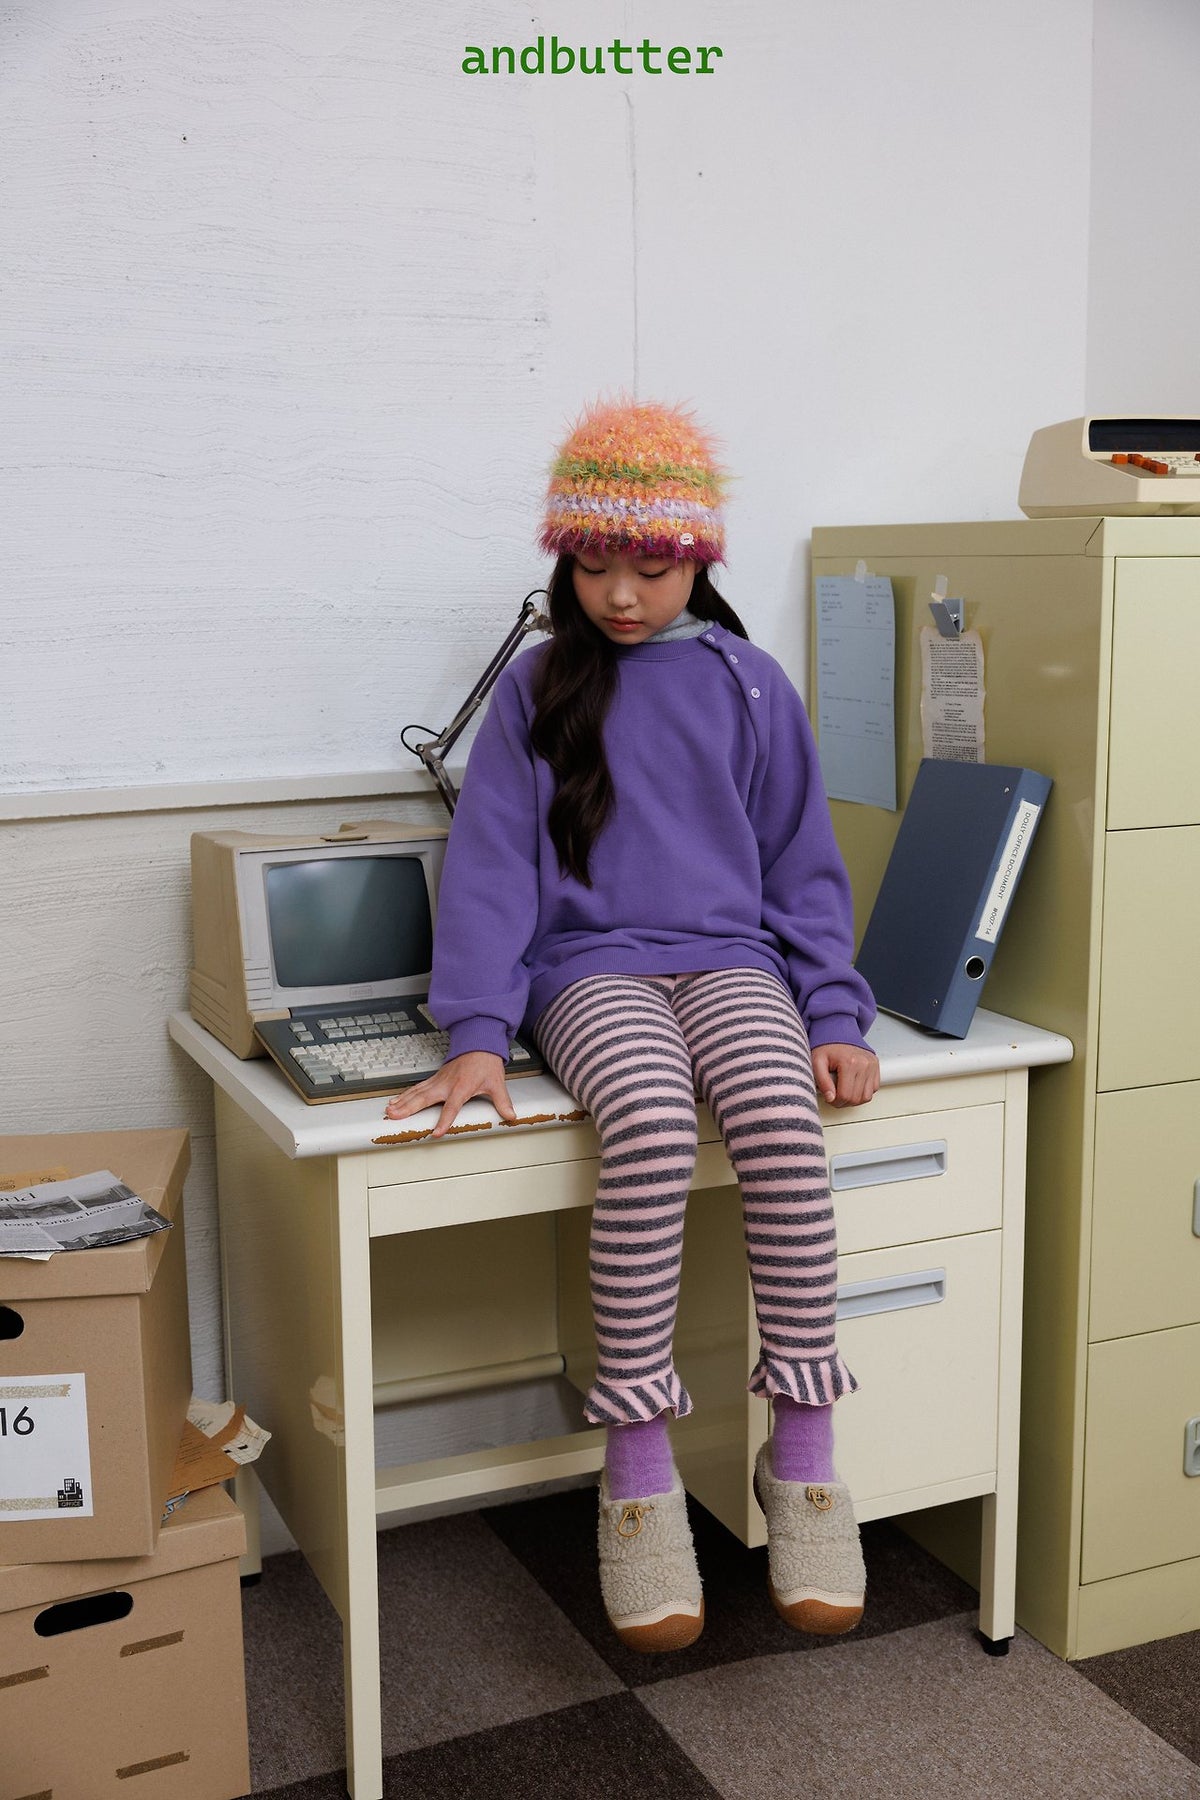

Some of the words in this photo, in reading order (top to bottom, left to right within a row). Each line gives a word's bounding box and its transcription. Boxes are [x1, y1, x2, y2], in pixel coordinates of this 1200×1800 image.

[1020, 812, 1031, 834] DOLLY
[1012, 834, 1023, 858] OFFICE
[997, 859, 1015, 899] DOCUMENT
